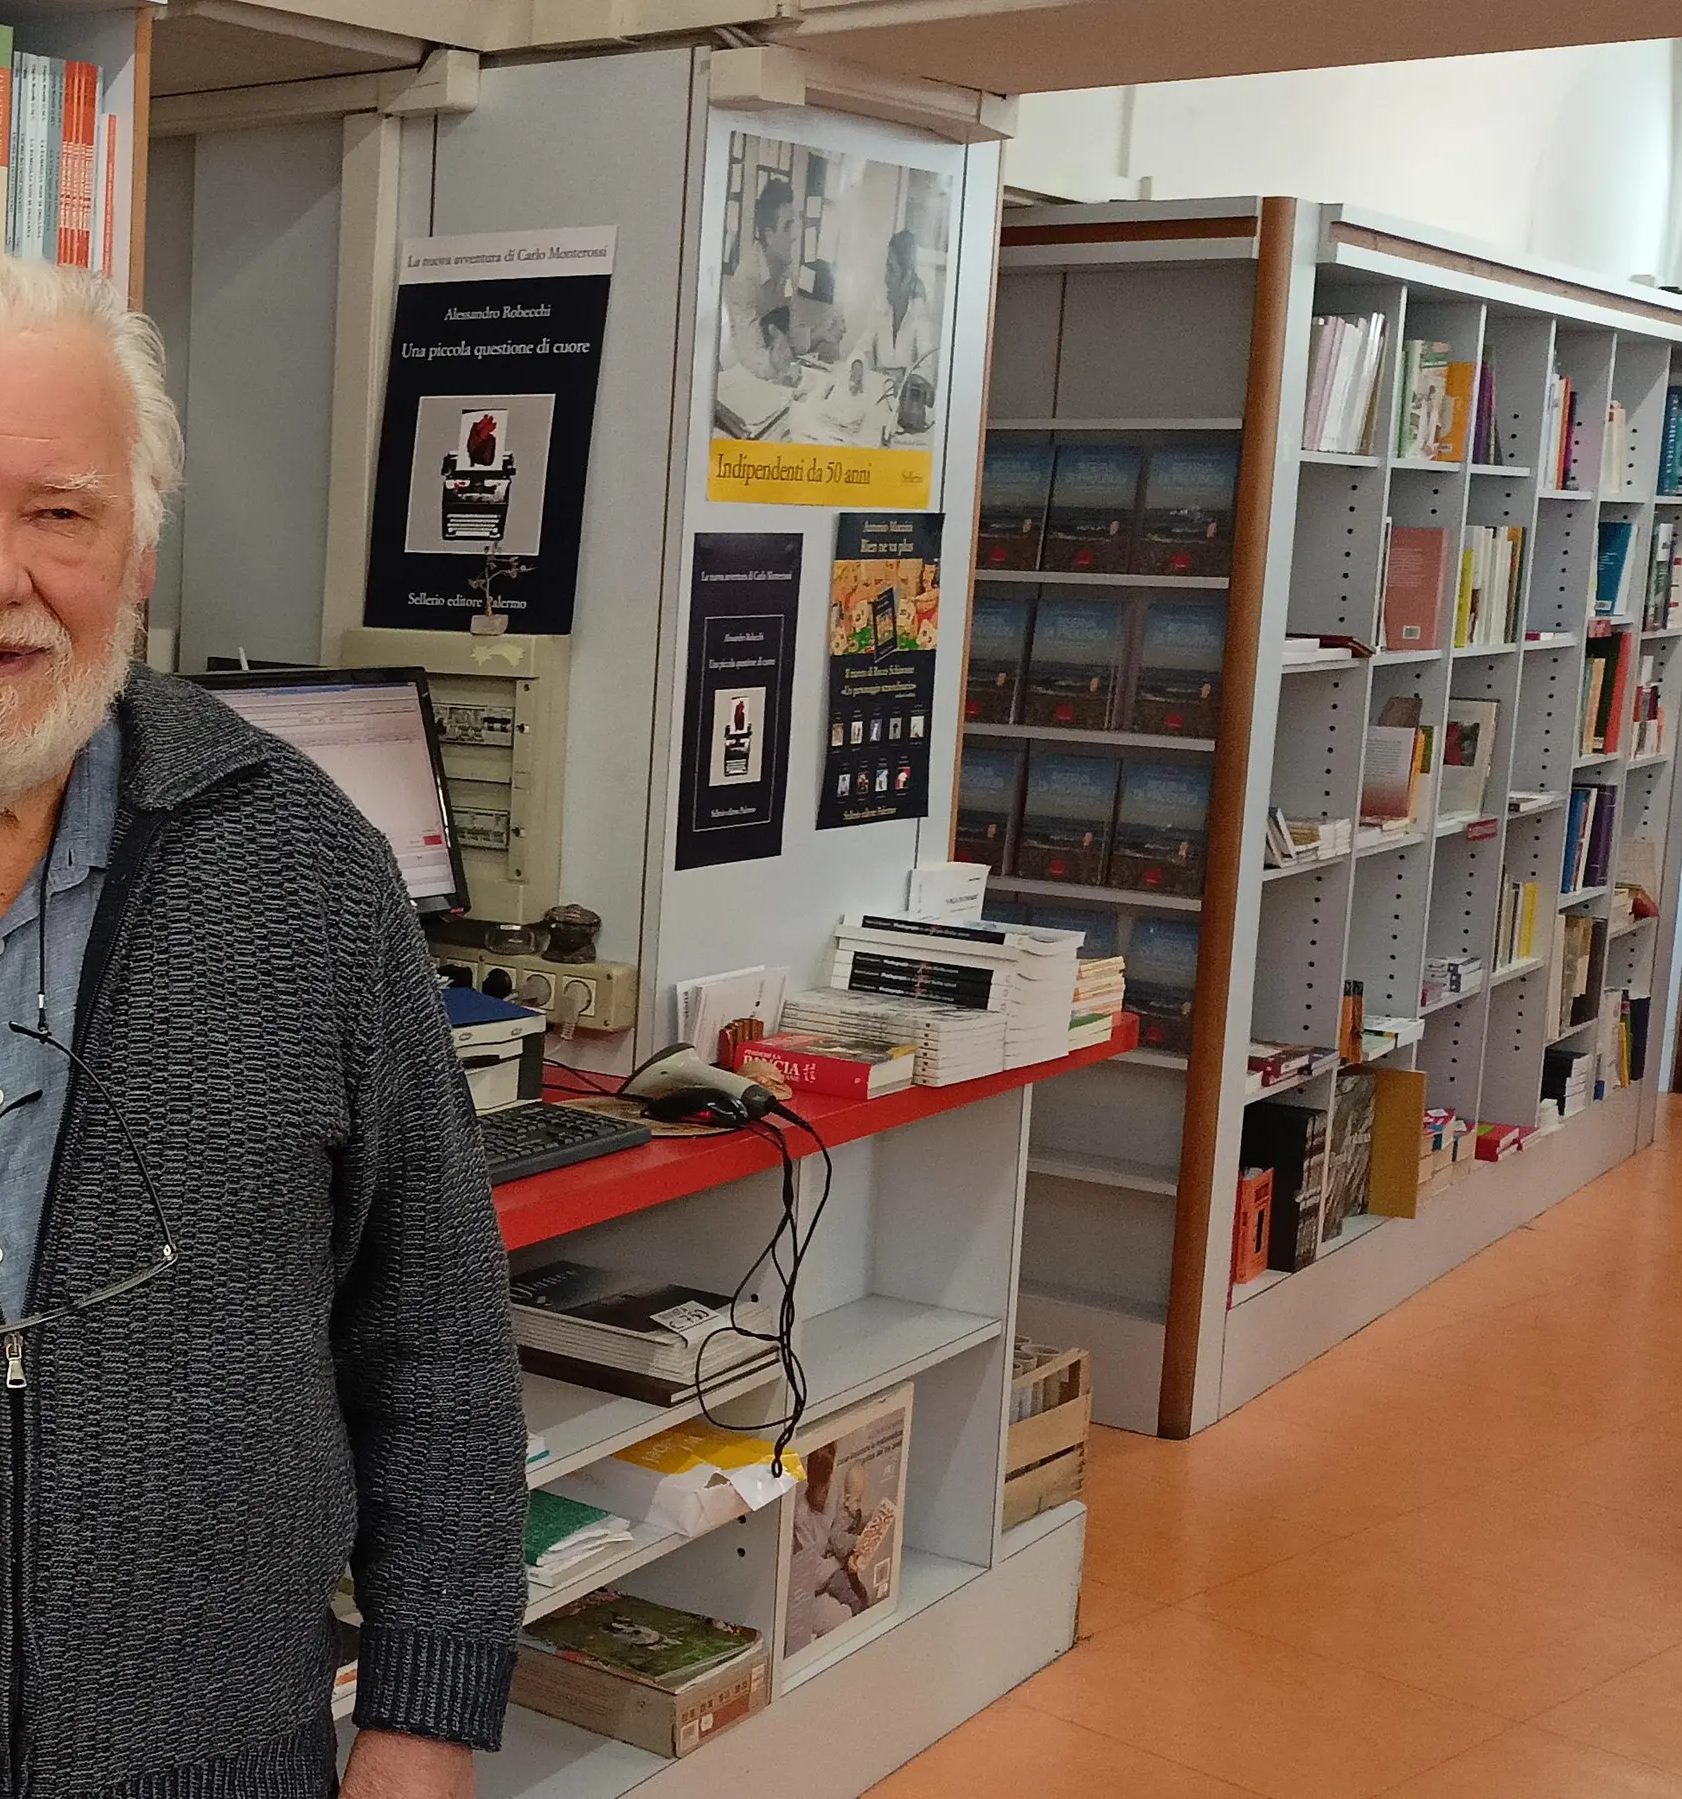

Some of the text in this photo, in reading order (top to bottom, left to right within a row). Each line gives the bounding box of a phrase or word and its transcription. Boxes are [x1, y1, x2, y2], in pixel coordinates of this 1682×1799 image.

[504, 248, 515, 263] di
[518, 246, 546, 262] Carlo
[547, 244, 608, 261] Monterossi
[444, 304, 552, 321] Alessandro Robecchi
[401, 337, 591, 361] Una piccola questione di cuore
[716, 453, 871, 486] Indipendenti da 50 anni
[408, 592, 483, 608] Sellerio editore
[743, 1055, 800, 1076] PCIA
